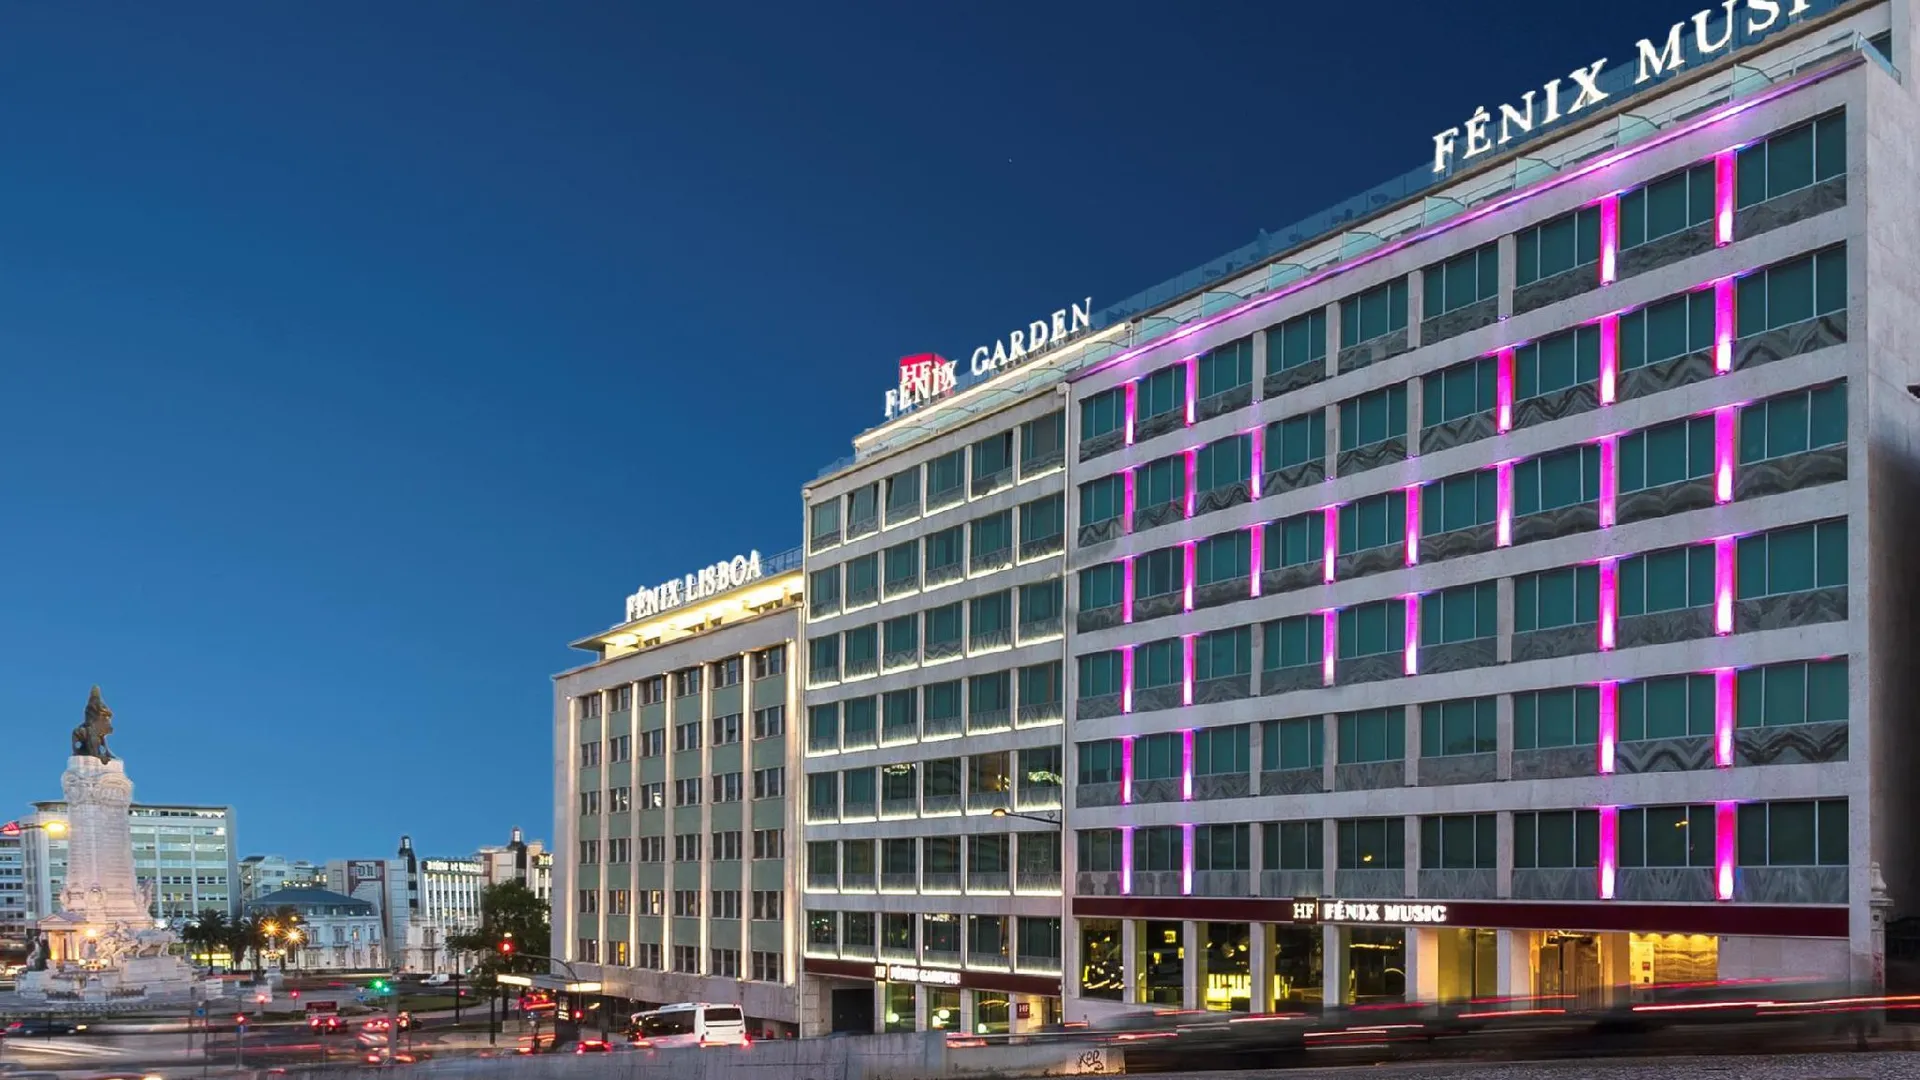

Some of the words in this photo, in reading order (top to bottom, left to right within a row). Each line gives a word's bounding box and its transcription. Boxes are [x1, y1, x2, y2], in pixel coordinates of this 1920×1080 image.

[1432, 58, 1609, 173] FÉNIX
[971, 297, 1092, 376] GARDEN
[625, 578, 681, 623] FÉNIX
[684, 549, 762, 602] LISBOA
[1293, 902, 1315, 919] HF
[1324, 900, 1380, 921] FÉNIX
[1384, 904, 1447, 922] MUSIC
